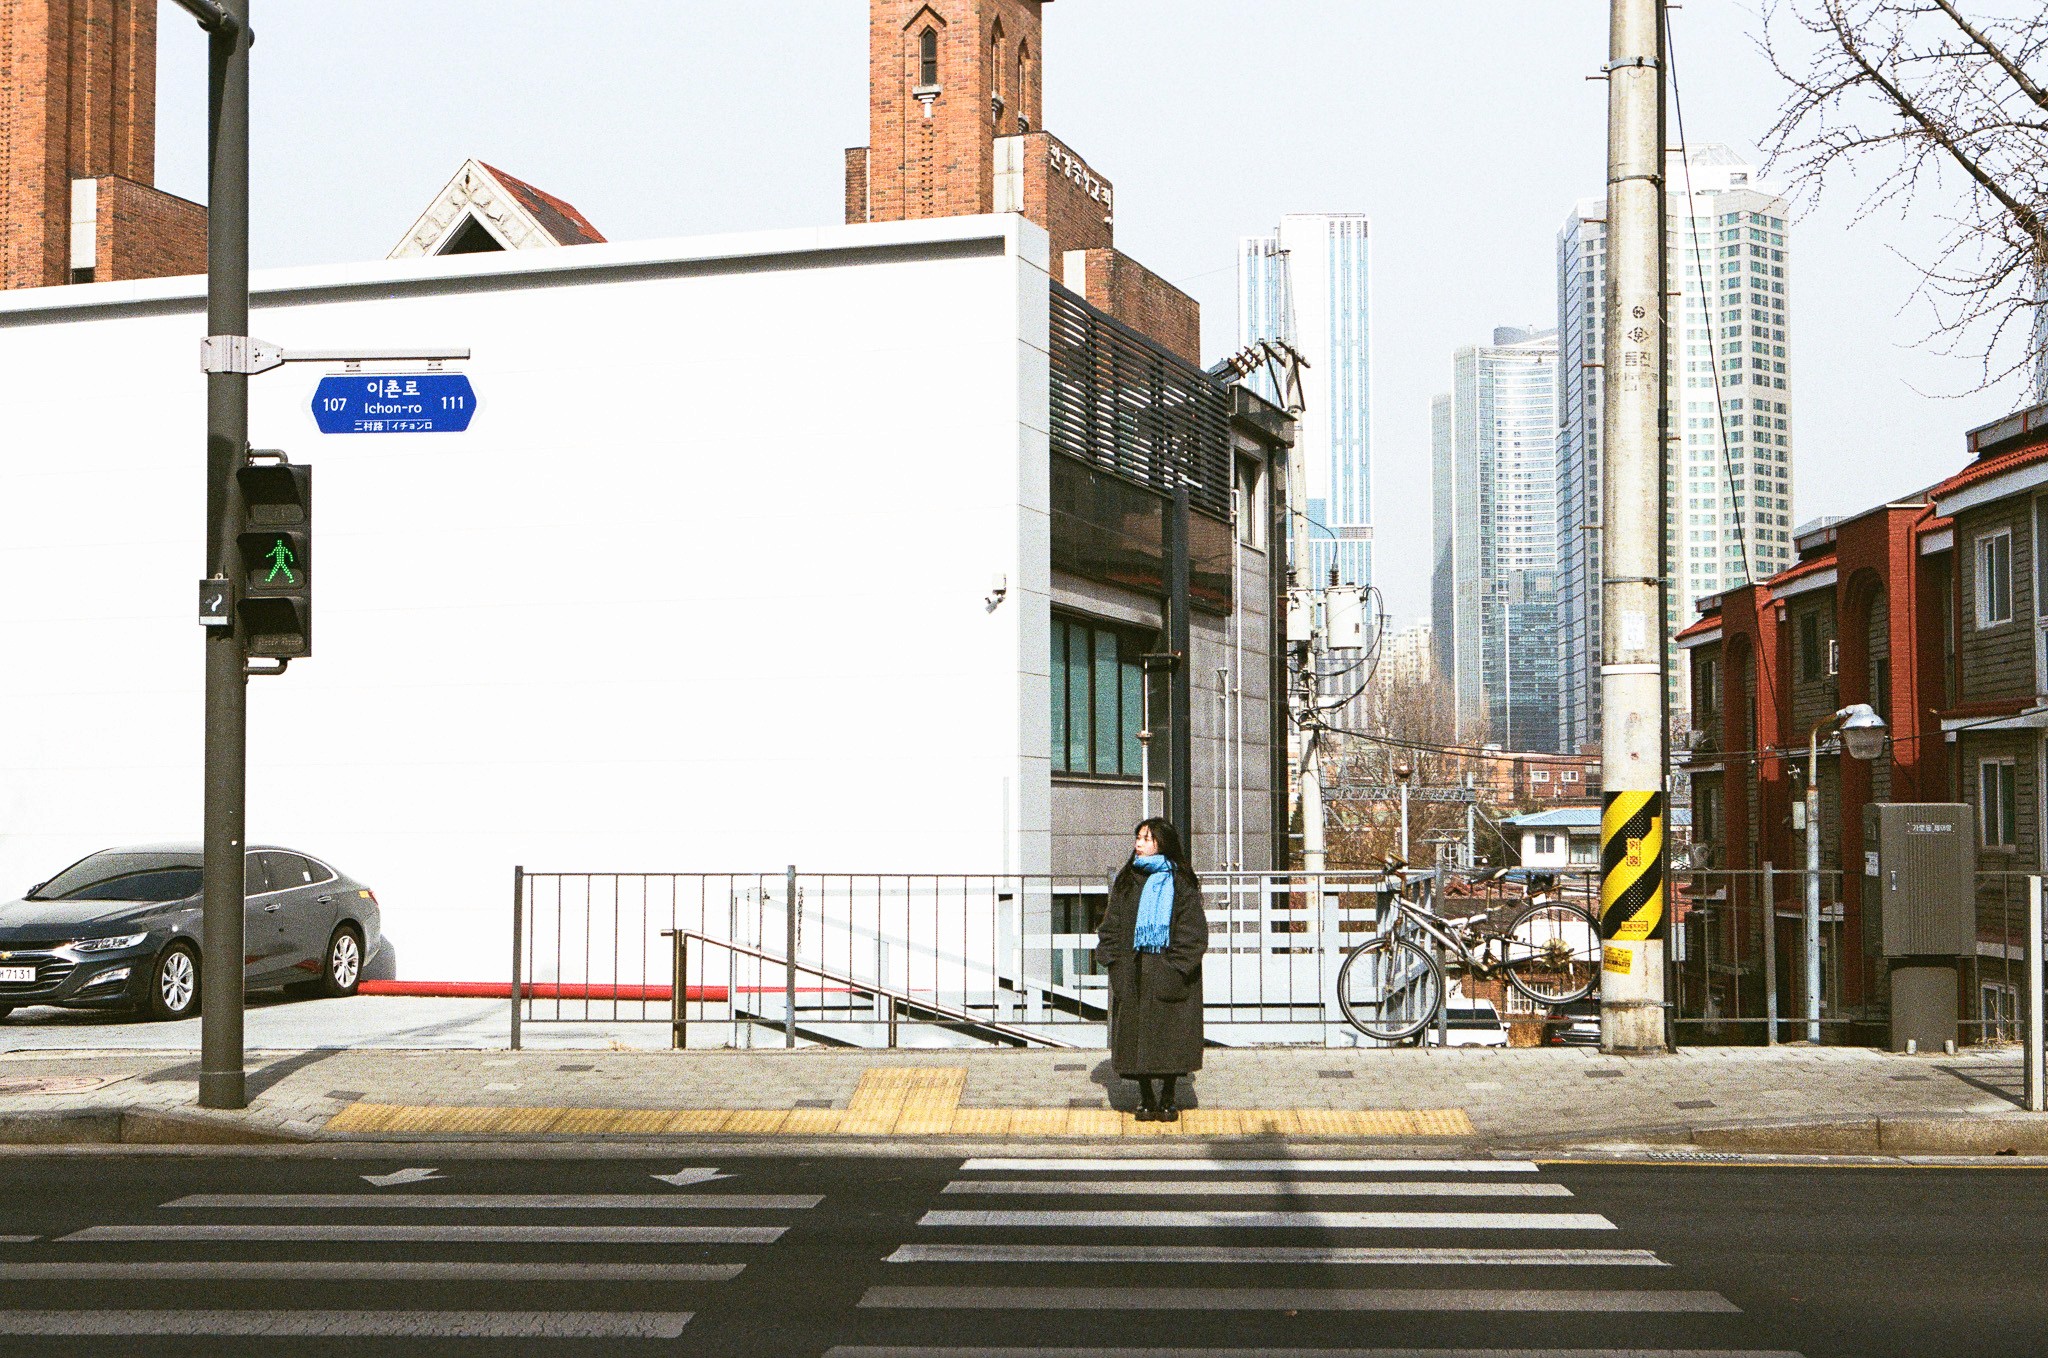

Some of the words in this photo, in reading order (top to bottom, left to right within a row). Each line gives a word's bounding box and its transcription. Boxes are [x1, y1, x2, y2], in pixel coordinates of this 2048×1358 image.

[367, 379, 420, 398] 이촌로
[323, 398, 347, 411] 107
[364, 402, 422, 414] Ichon-ro
[441, 396, 464, 410] 111
[353, 421, 383, 431] 二村路
